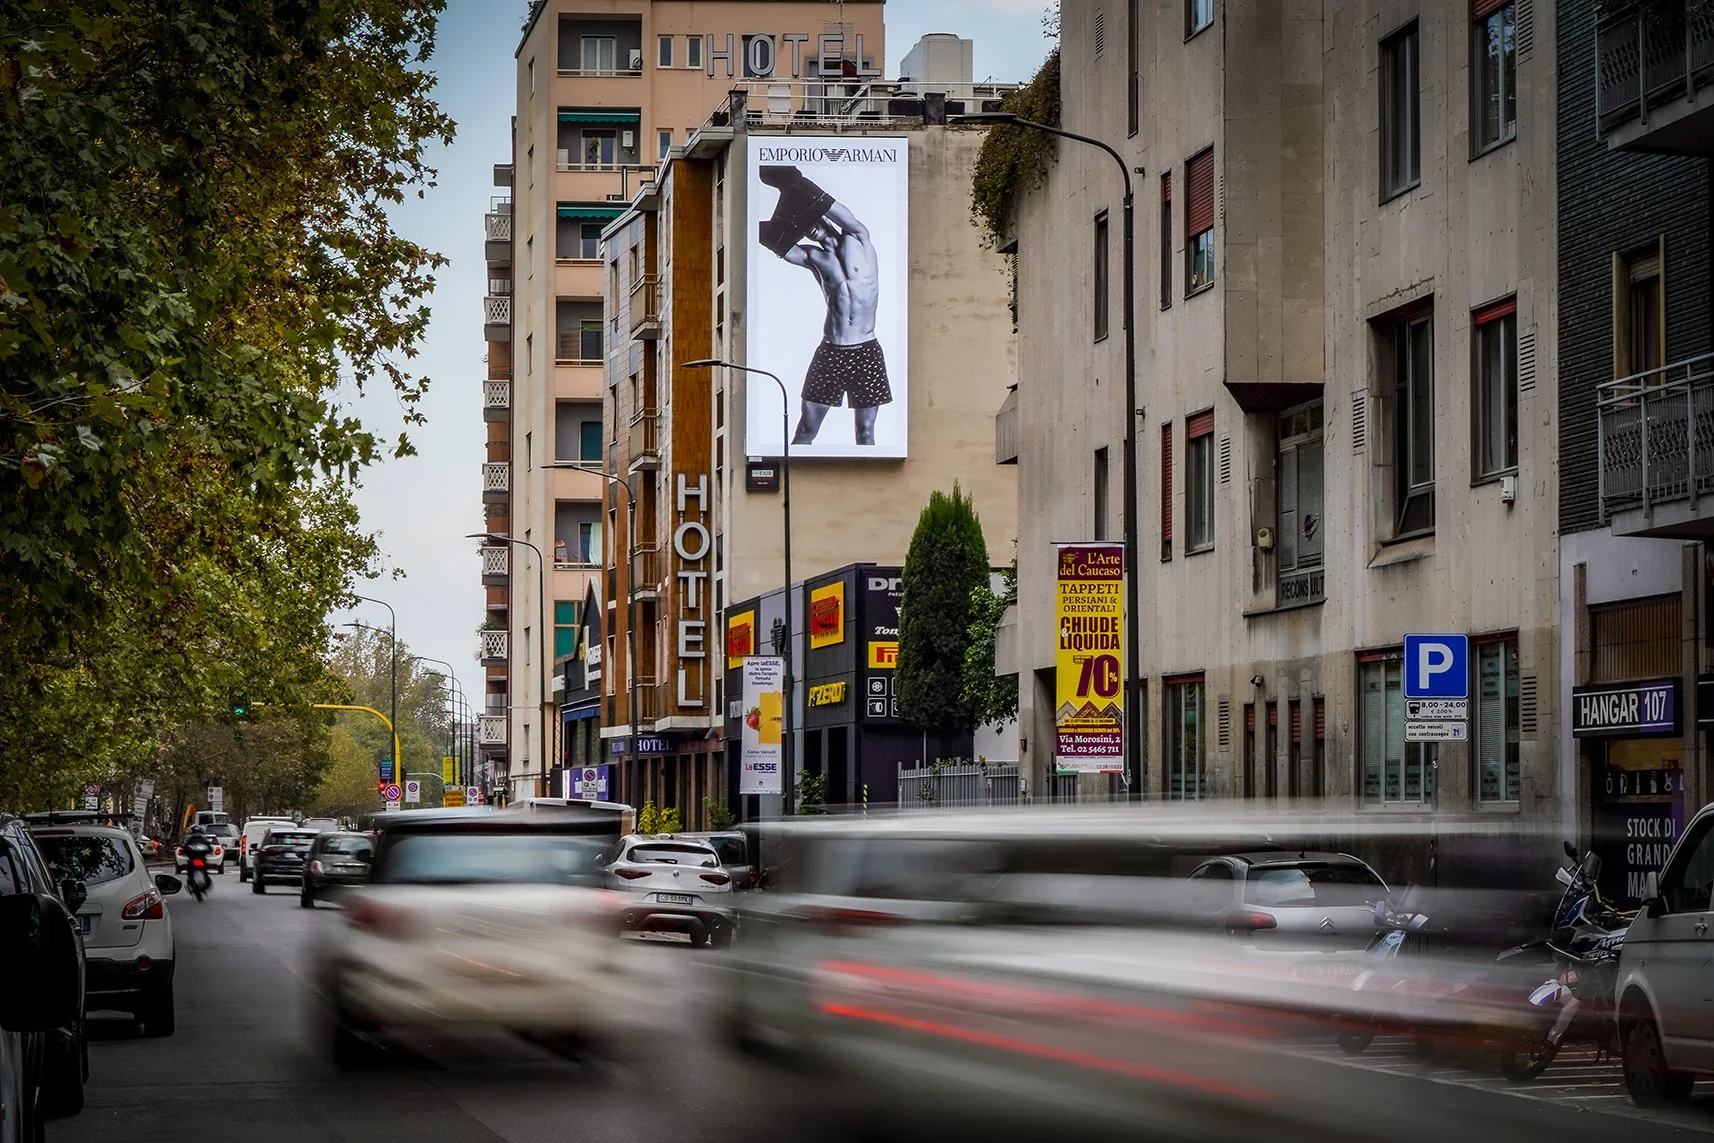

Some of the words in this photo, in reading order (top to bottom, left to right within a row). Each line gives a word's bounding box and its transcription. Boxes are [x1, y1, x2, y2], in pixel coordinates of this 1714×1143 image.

[706, 33, 882, 77] HOTEL
[759, 147, 823, 162] EMPORIO
[842, 149, 897, 163] ARMANI
[1087, 552, 1120, 565] L'Arte
[1059, 564, 1075, 576] del
[1078, 564, 1121, 577] Caucaso
[674, 473, 711, 707] HOTEL
[1060, 583, 1119, 595] TAPPETI
[1062, 596, 1108, 604] PERSIANI
[1109, 596, 1117, 604] &
[1063, 605, 1116, 613] ORIENTALI
[1060, 616, 1119, 633] CHIUDE
[1060, 633, 1121, 652] LIQUIDA
[1418, 643, 1454, 689] P
[1580, 694, 1639, 726] HANGAR
[1644, 690, 1667, 722] 107
[1059, 734, 1073, 743] Via
[1074, 734, 1114, 744] Morosini,
[1060, 744, 1076, 753] Tel.
[1088, 745, 1106, 754] 5465
[1107, 746, 1119, 754] 711
[1627, 818, 1661, 838] STOCK
[1664, 818, 1676, 838] DI
[1627, 843, 1673, 866] GRAND
[1627, 871, 1648, 898] MA
